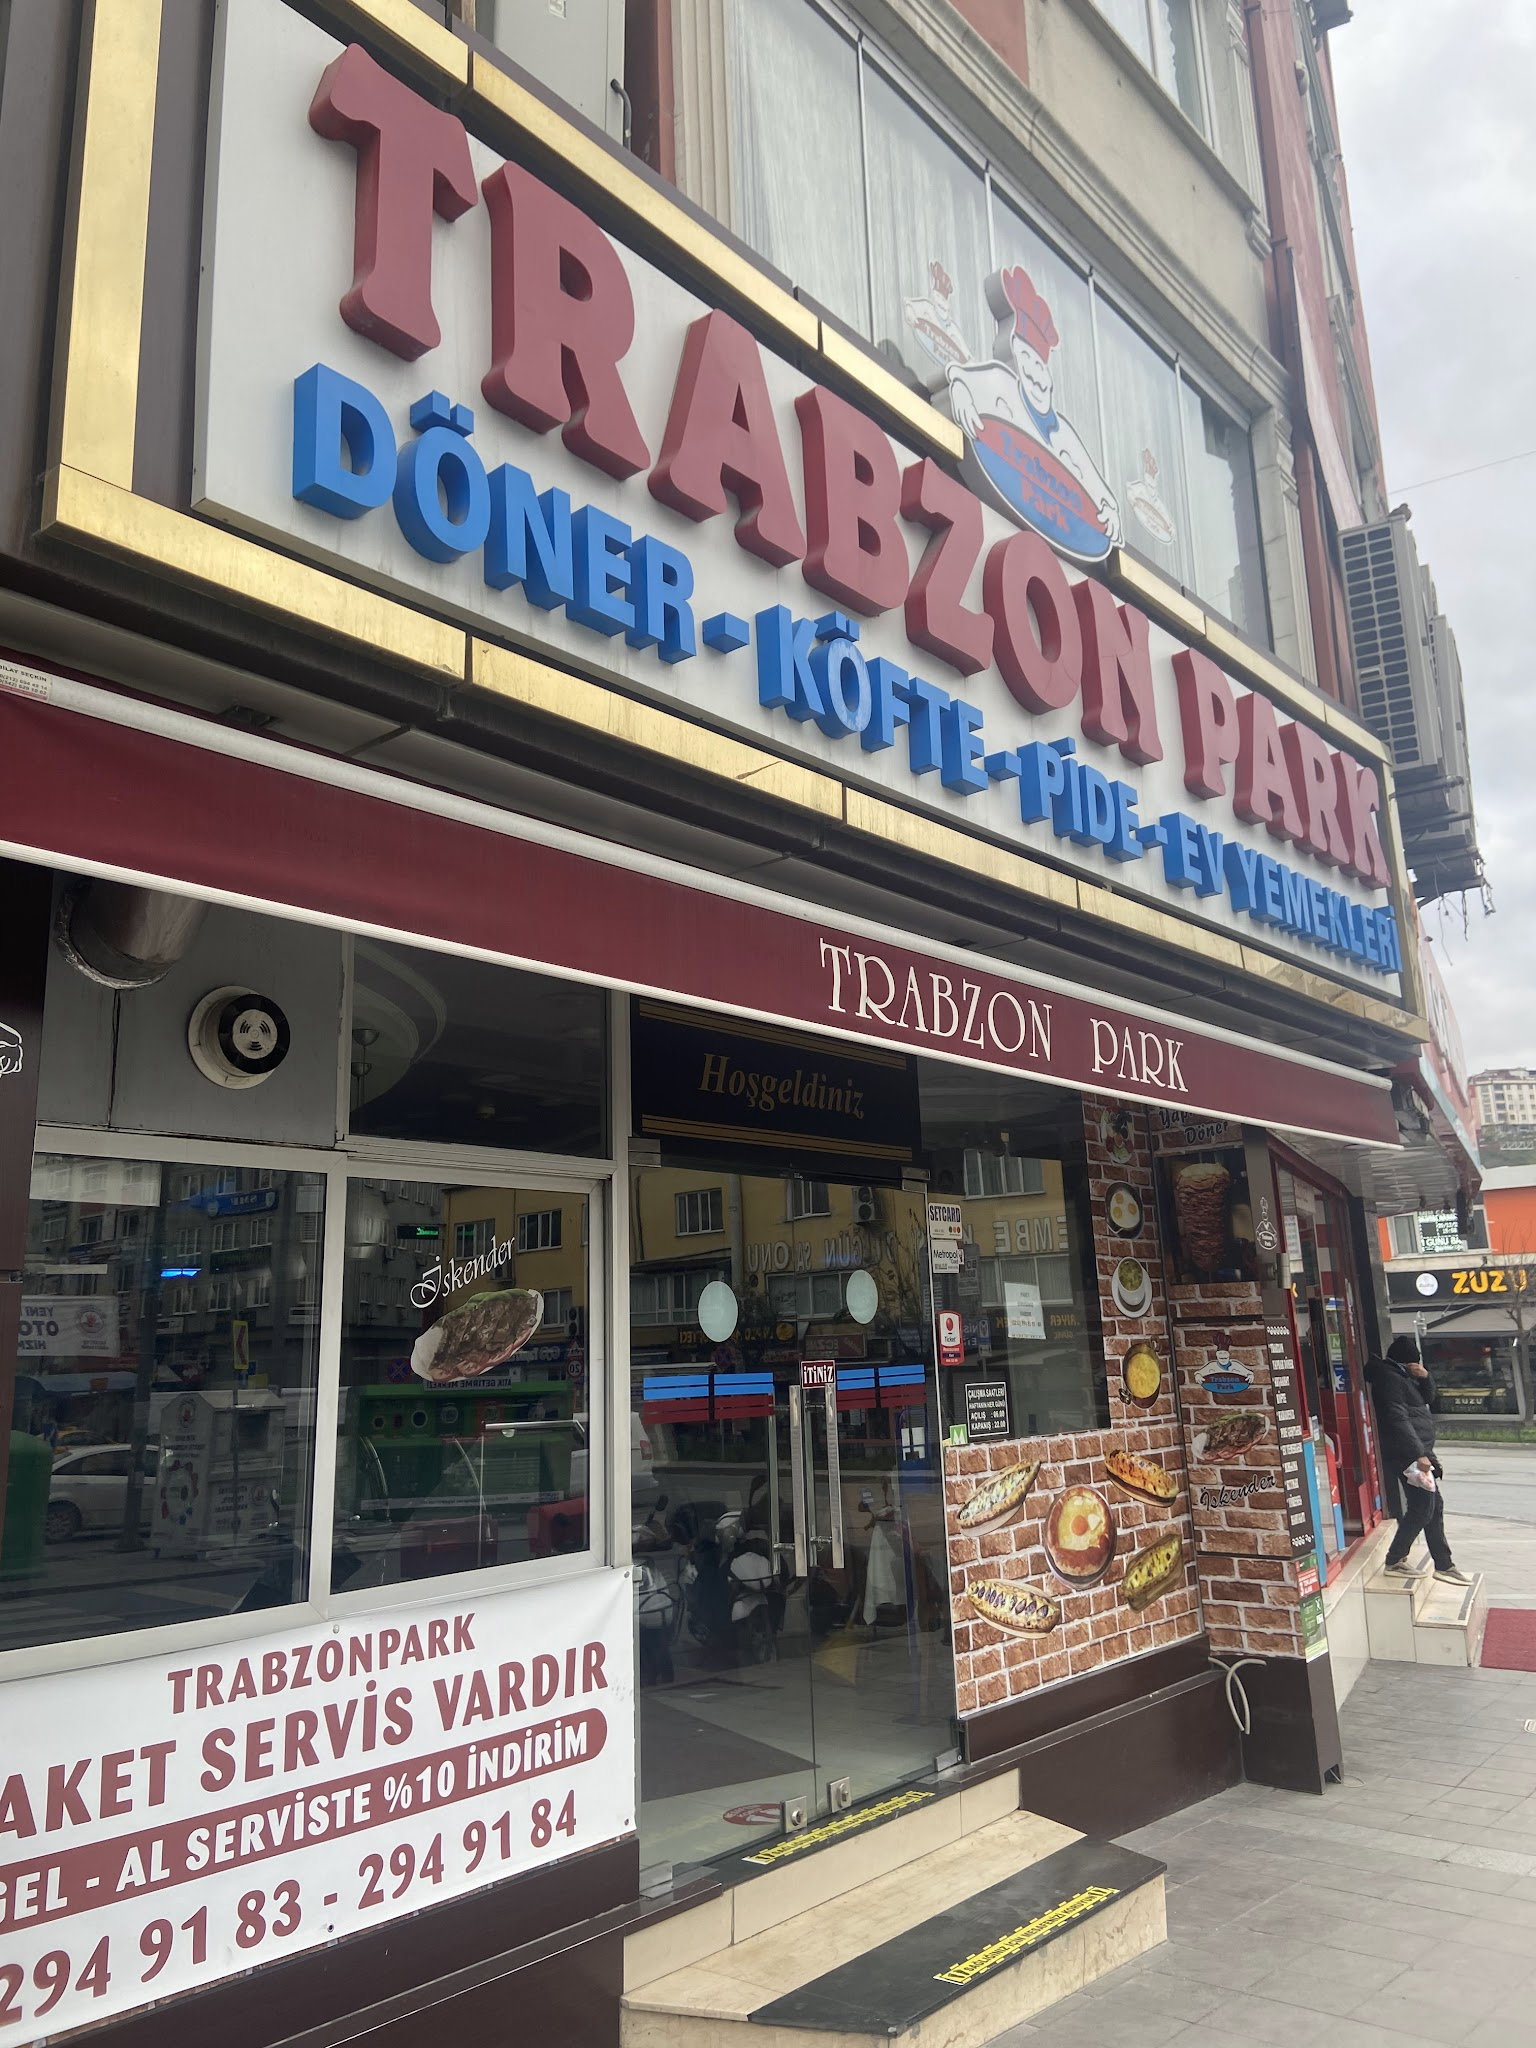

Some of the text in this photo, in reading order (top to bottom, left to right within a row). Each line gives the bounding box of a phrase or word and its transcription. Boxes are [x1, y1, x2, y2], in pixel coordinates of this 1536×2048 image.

[308, 43, 1392, 889] TRABZON PARK
[1020, 475, 1070, 534] Park
[293, 362, 697, 664] DÖNER
[755, 604, 988, 796] KÖFTE
[1017, 737, 1143, 862] PİDE
[1160, 812, 1223, 897] EV
[1223, 842, 1402, 975] YEMEKLERİ
[820, 937, 1190, 1094] TRABZON PARK
[698, 1053, 865, 1119] Hoşgeldiniz
[1184, 1121, 1229, 1145] Döner
[929, 1205, 961, 1222] SETCARD
[410, 1235, 516, 1309] İskender
[1451, 1268, 1528, 1295] ZUZU
[971, 1421, 991, 1430] KAPANIŞ
[1200, 1473, 1277, 1512] İskender
[167, 1613, 476, 1715] TRABZONPARK
[199, 1680, 414, 1794] SERVİS
[432, 1641, 609, 1732] VARDIR
[116, 1848, 170, 1893] AL
[185, 1791, 371, 1871] SERVİSTE
[383, 1760, 455, 1811] %10
[467, 1720, 588, 1790] İNDİRİM
[0, 1936, 111, 2027] 294
[139, 1905, 208, 1983] 91
[235, 1878, 303, 1949] 83
[357, 1831, 445, 1910] 294
[463, 1810, 513, 1873] 91
[530, 1788, 578, 1849] 84
